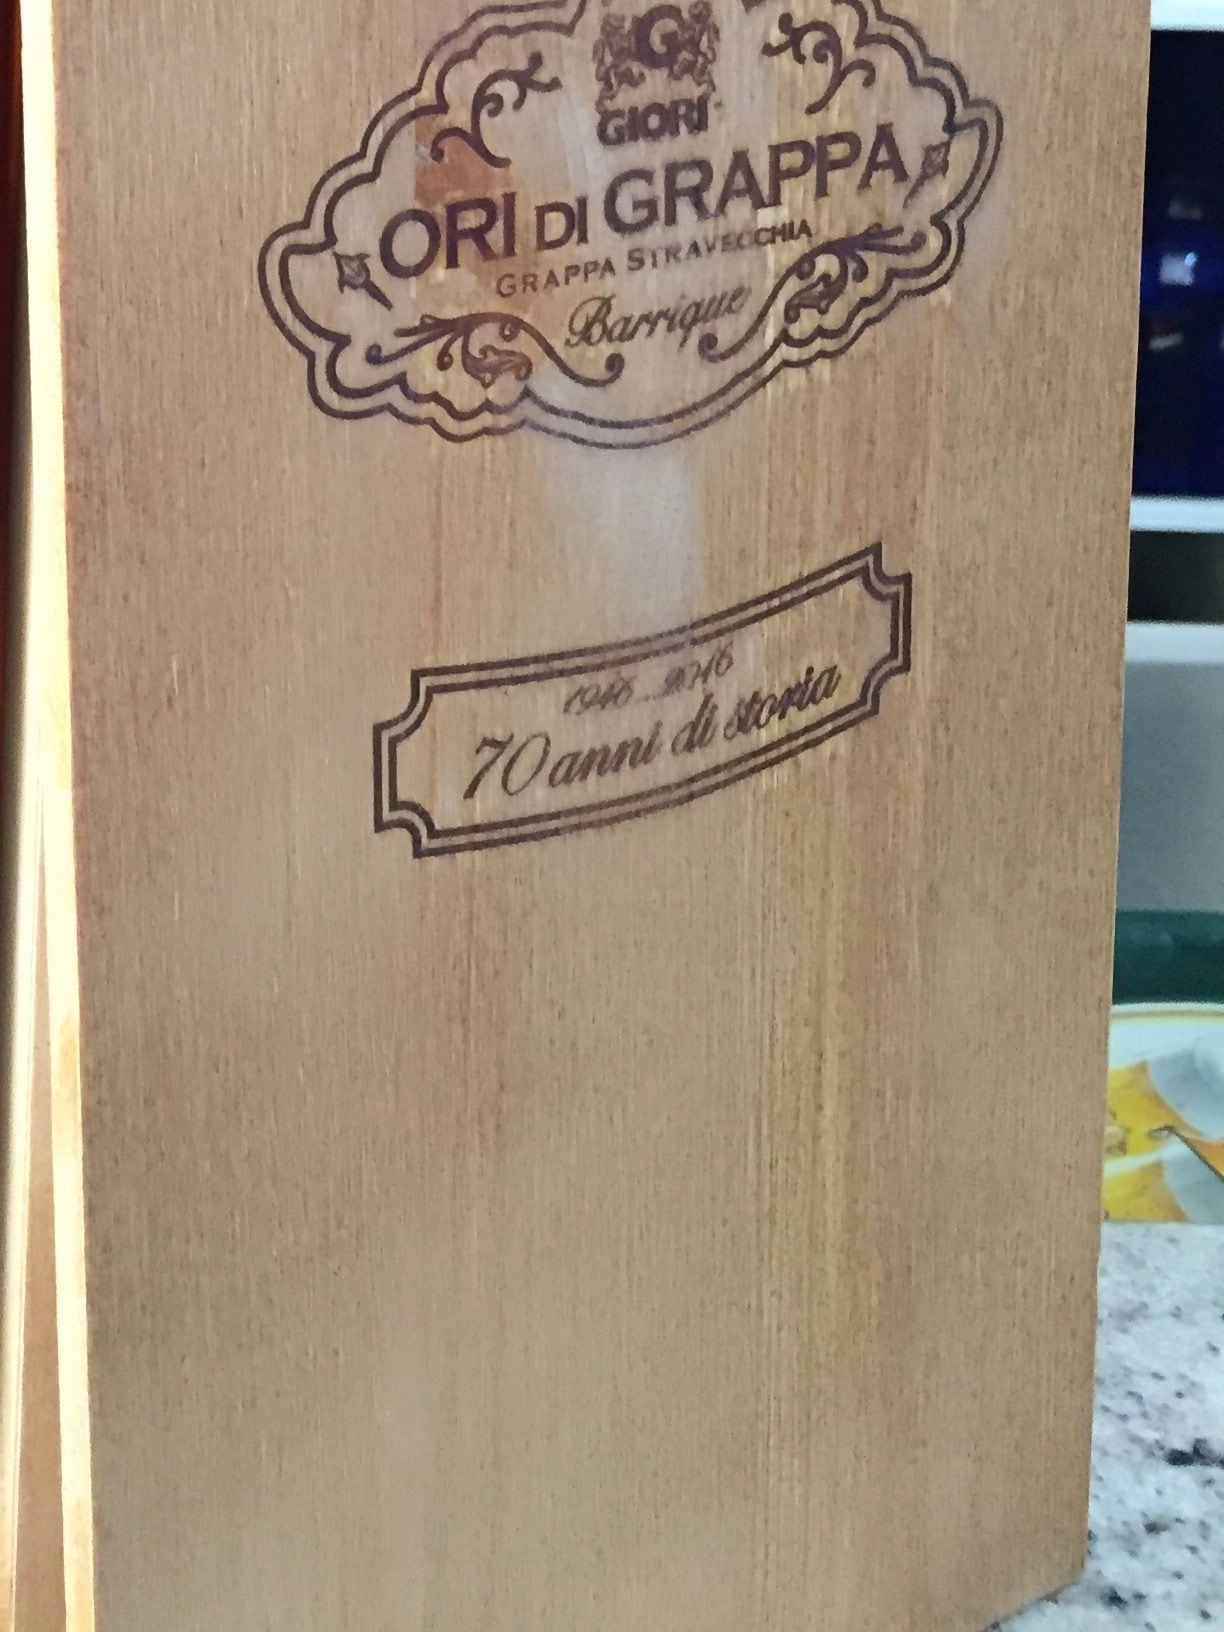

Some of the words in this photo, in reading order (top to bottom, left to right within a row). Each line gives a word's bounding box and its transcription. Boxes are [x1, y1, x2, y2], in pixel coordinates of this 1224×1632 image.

[634, 4, 684, 69] G
[597, 94, 709, 146] GIORI
[379, 192, 516, 279] ORI
[536, 197, 589, 255] DI
[604, 123, 910, 236] GRAPPA
[495, 258, 616, 299] GRAPPA
[626, 220, 813, 273] STRAVECCHIA
[565, 282, 751, 355] Barrique
[462, 730, 551, 801] 70
[548, 721, 662, 785] anni
[671, 690, 719, 756] di
[723, 664, 843, 741] storia
